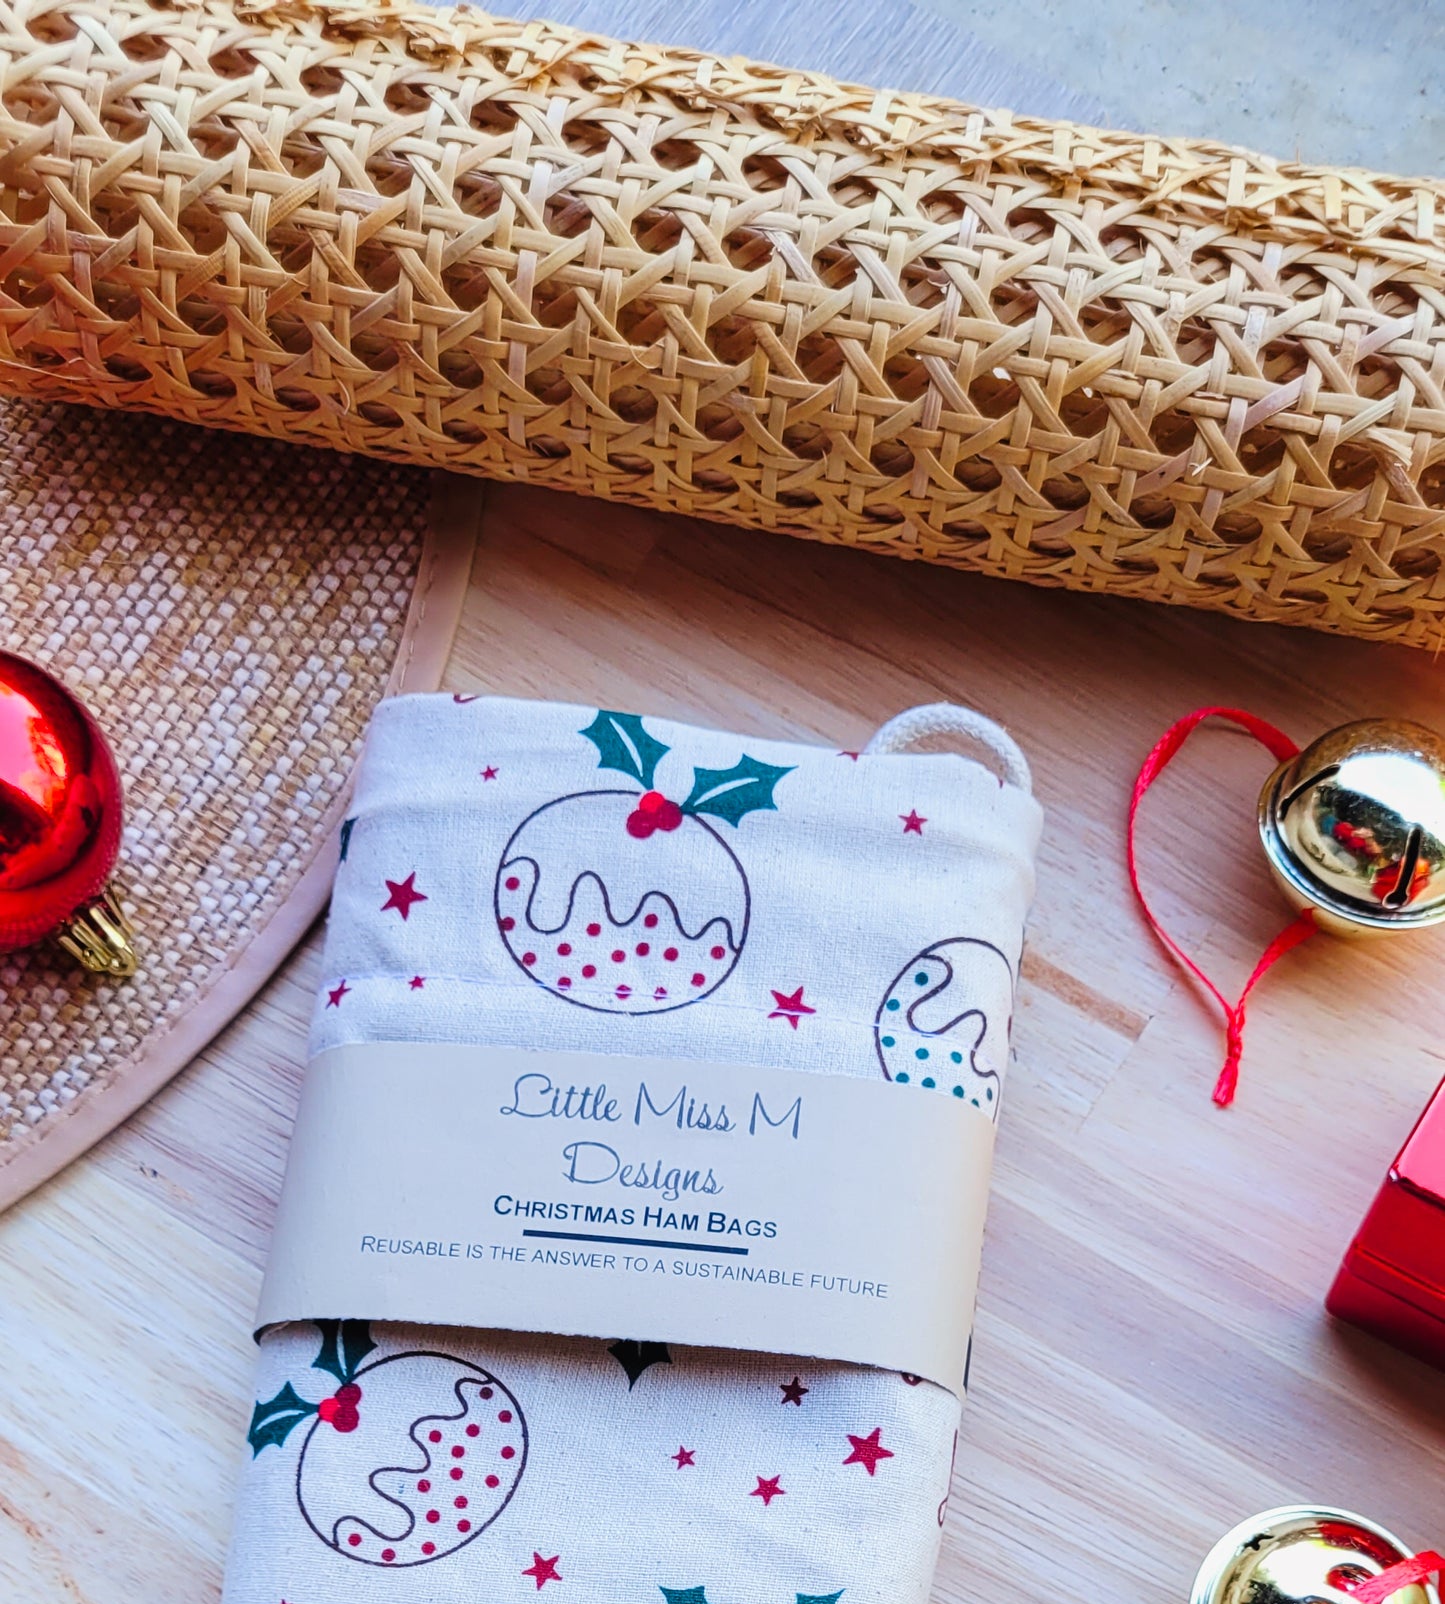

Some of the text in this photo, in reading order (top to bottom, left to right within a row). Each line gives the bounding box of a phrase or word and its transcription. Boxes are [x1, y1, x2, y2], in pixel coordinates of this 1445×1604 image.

[500, 1073, 802, 1139] Little Miss M
[562, 1141, 724, 1201] Designs
[466, 1243, 484, 1260] IS
[489, 1245, 527, 1263] THE
[531, 1248, 616, 1271] ANSWER
[622, 1255, 649, 1272] TO
[653, 1258, 666, 1274] A
[672, 1261, 805, 1288] SUSTAINABLE
[810, 1273, 889, 1299] FUTURE
